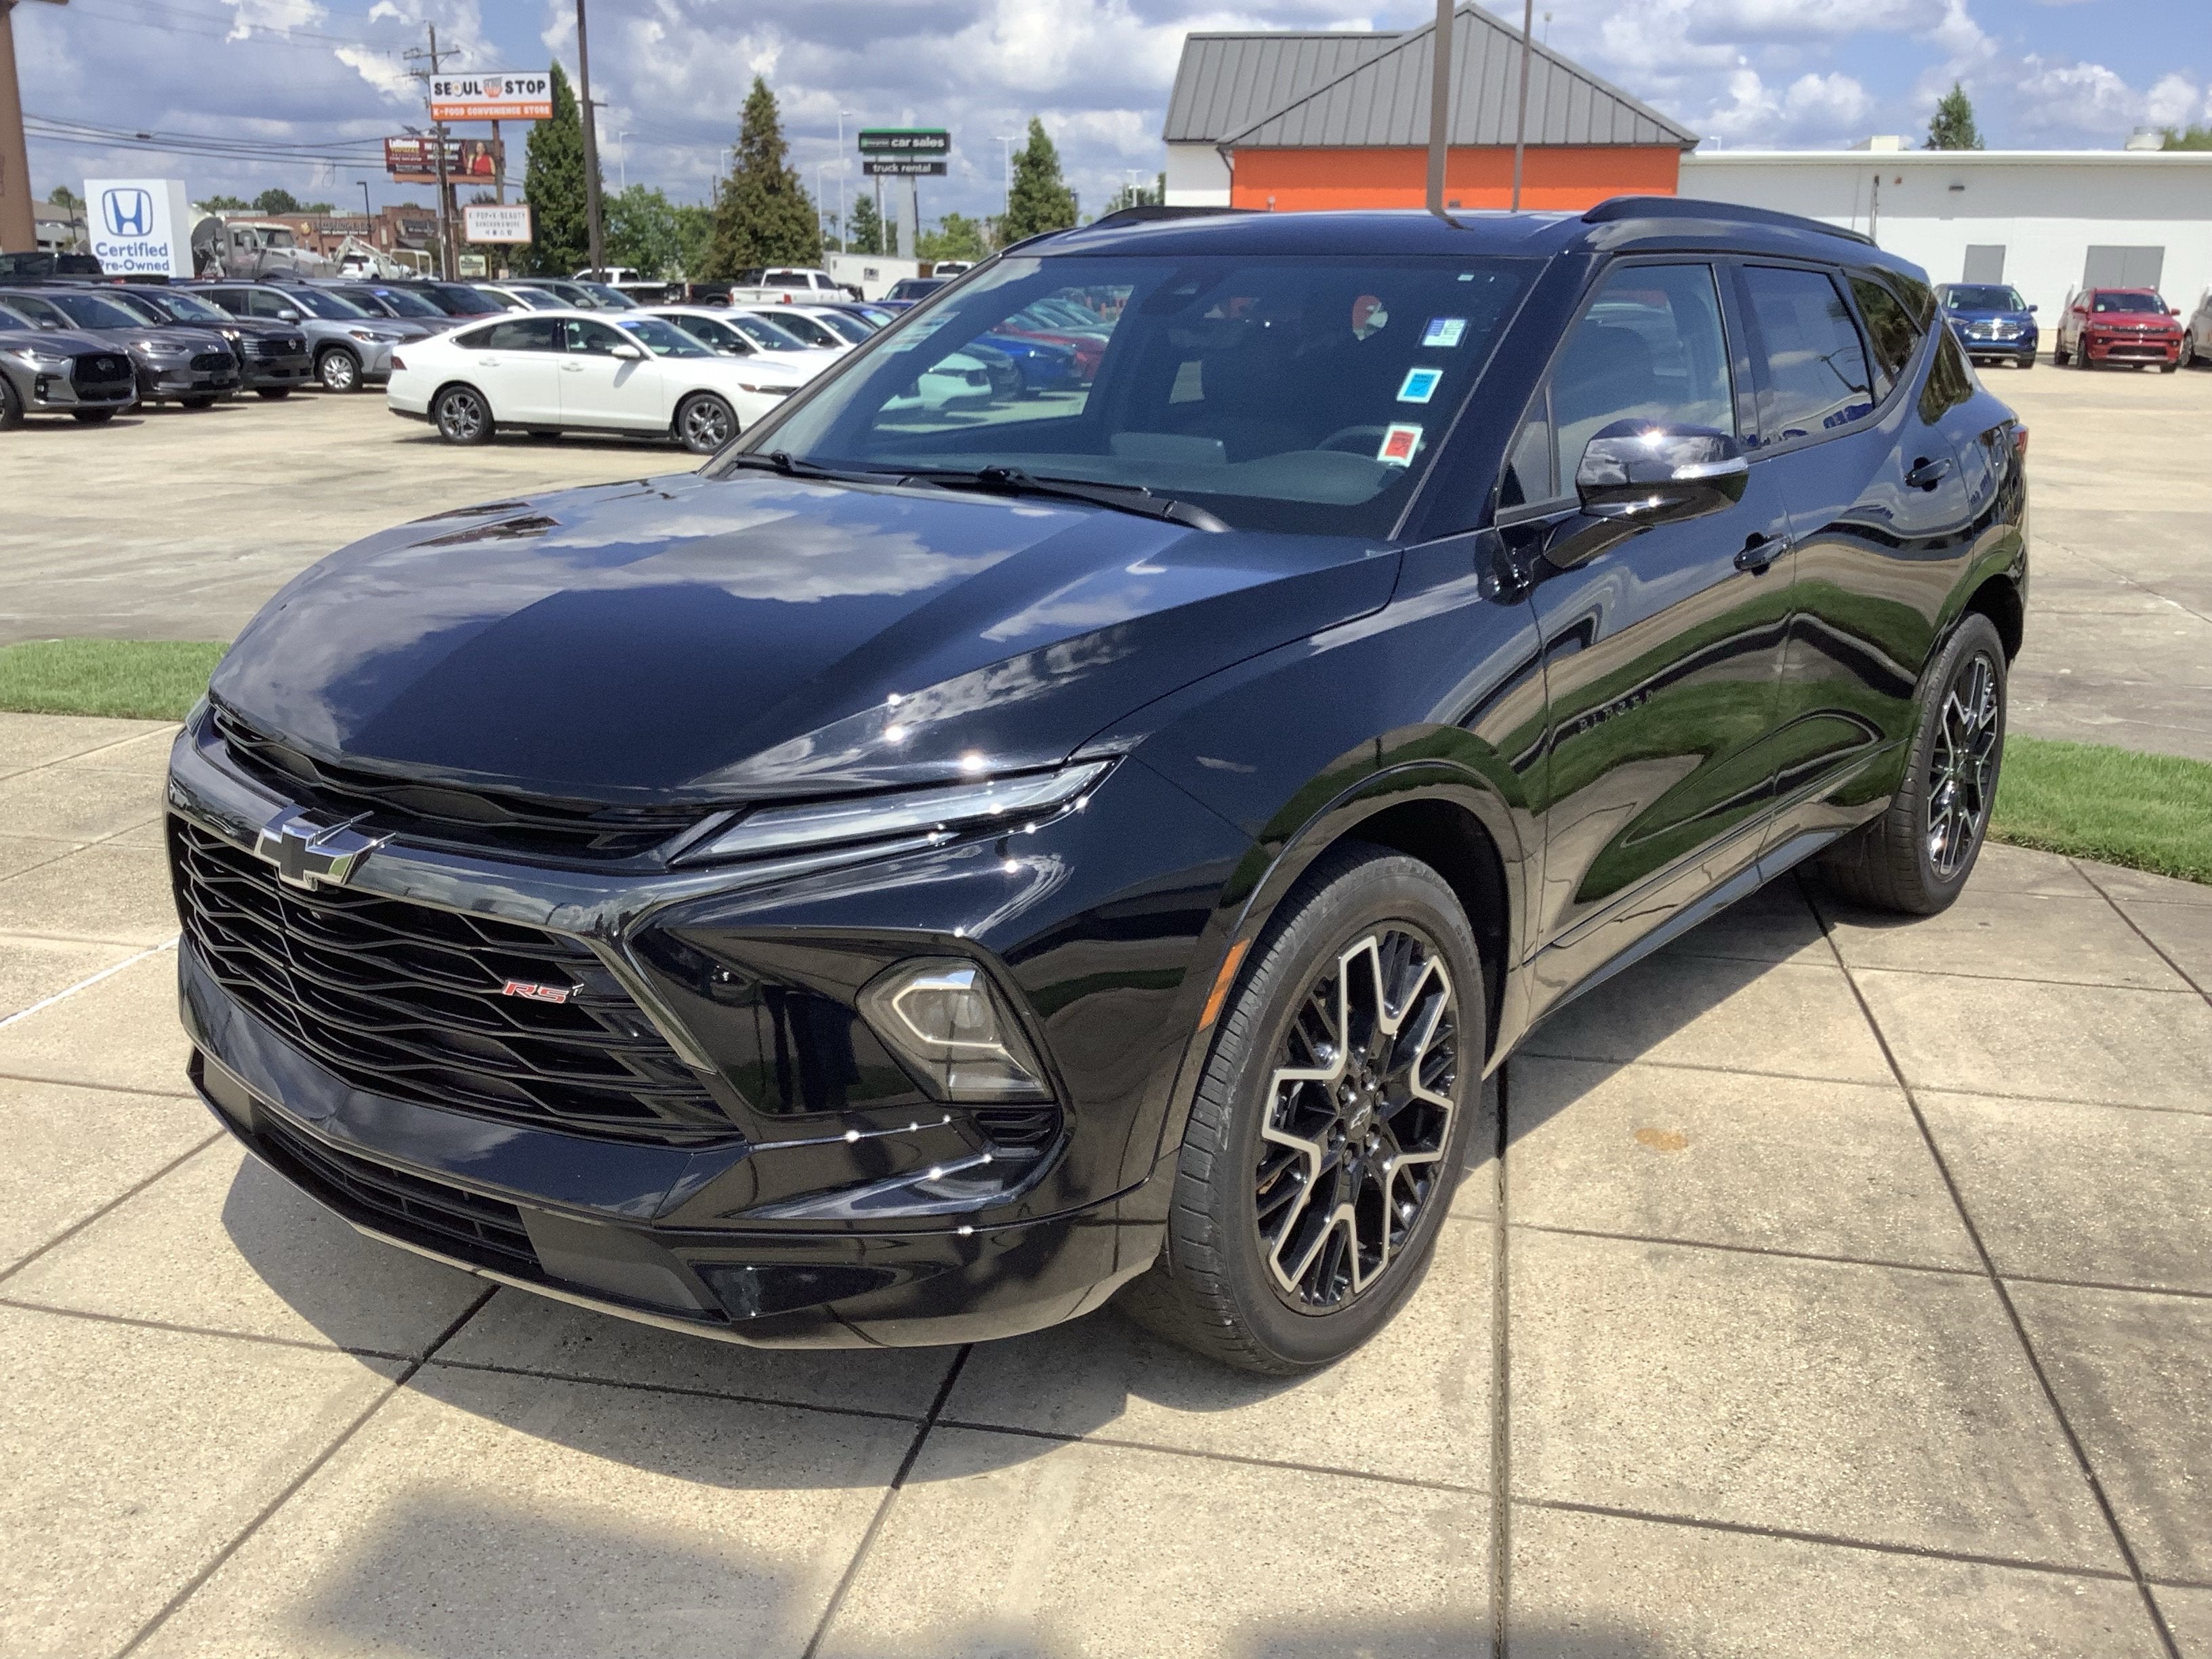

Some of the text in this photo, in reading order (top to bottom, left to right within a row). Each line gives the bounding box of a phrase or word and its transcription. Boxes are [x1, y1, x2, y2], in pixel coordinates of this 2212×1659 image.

[434, 80, 546, 97] SEOUL STOP
[433, 105, 550, 117] K-FOOD CONVENIENCE STORE
[890, 138, 912, 148] car
[912, 136, 945, 148] sales
[872, 163, 931, 173] truck rental
[96, 242, 168, 257] Certified
[502, 980, 569, 1004] RS
